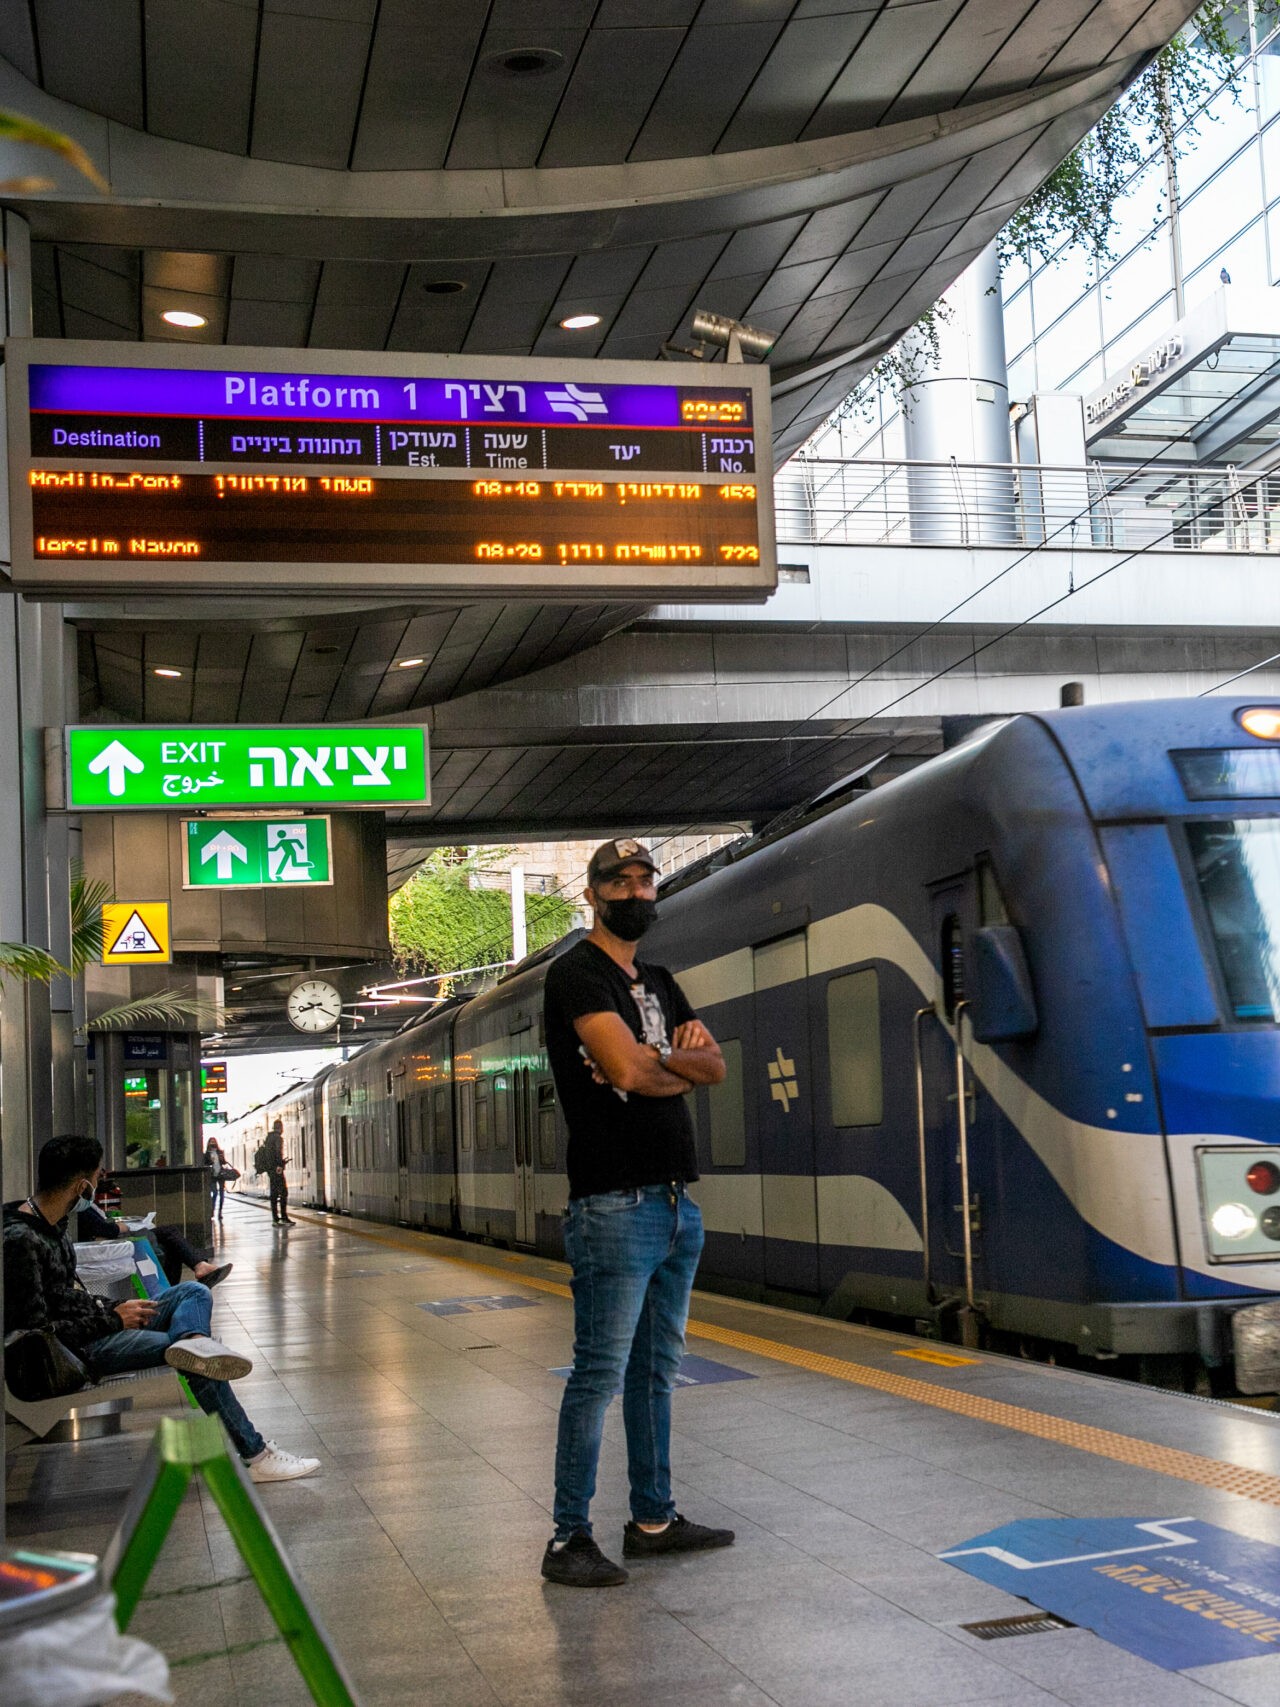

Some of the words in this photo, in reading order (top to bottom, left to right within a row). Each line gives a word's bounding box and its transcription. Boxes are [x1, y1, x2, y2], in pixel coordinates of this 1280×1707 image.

[225, 377, 380, 409] Platform
[403, 382, 417, 411] 1
[444, 383, 527, 419] רציף
[53, 428, 161, 448] Destination
[231, 435, 292, 453] ביניים
[298, 436, 362, 455] תחנות
[388, 431, 457, 450] מעודכן
[484, 433, 528, 449] שעה
[710, 438, 754, 454] רכבת
[408, 451, 440, 467] Est.
[485, 453, 528, 469] Time
[608, 445, 641, 460] יעד
[720, 457, 747, 473] No.
[161, 742, 226, 763] EXIT
[249, 746, 407, 787] יציאה
[162, 769, 225, 797] خروج
